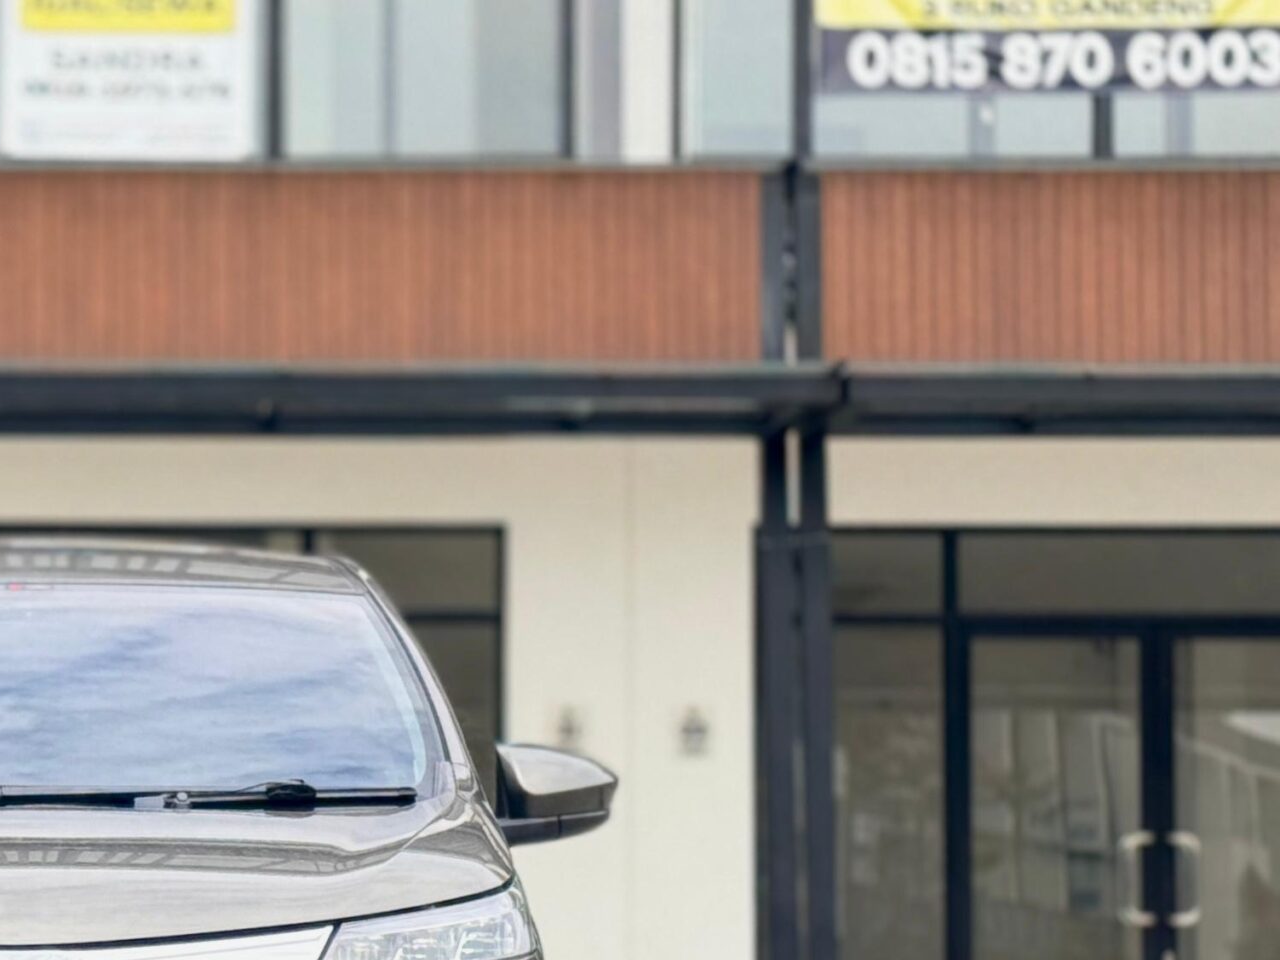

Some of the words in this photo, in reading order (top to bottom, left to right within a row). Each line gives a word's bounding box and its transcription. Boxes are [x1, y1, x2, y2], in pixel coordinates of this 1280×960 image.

[846, 30, 989, 90] 0815
[1000, 30, 1115, 90] 870
[1125, 30, 1280, 89] 6003
